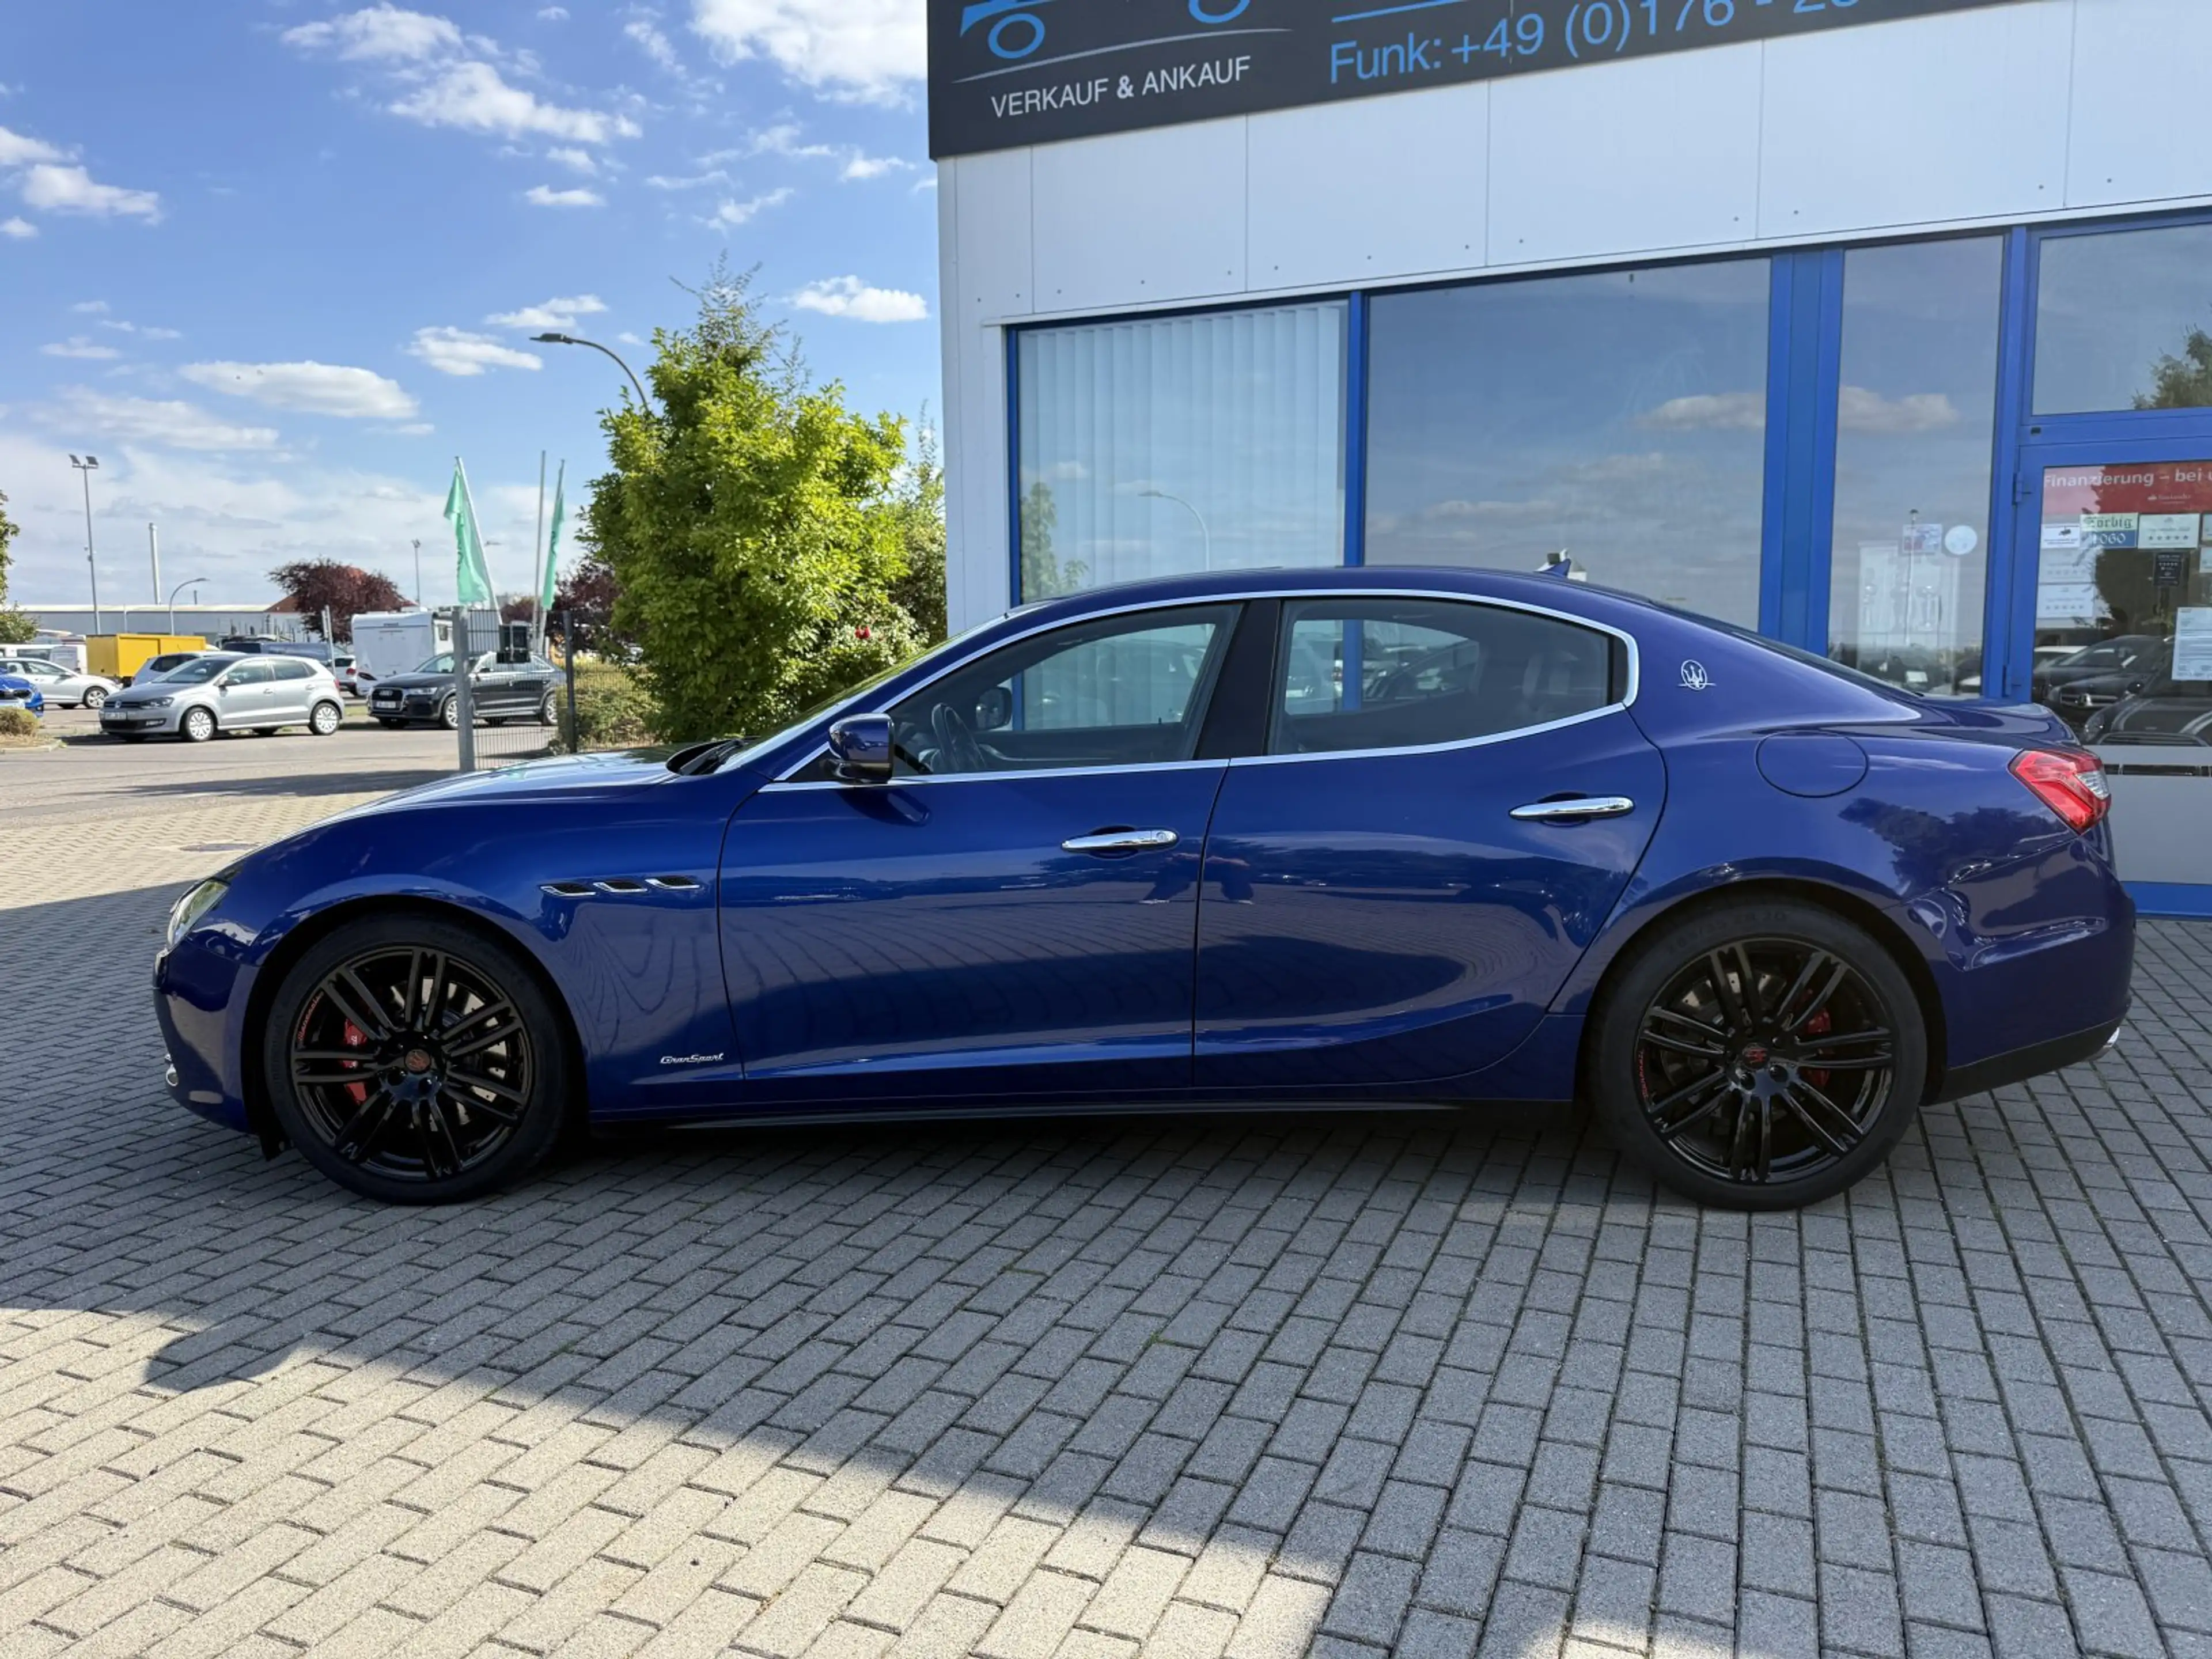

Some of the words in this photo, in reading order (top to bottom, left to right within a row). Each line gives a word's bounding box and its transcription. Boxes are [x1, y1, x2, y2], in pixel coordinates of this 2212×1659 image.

[991, 78, 1109, 118] VERKAUF
[1116, 74, 1135, 100] &
[1141, 55, 1251, 96] ANKAUF
[2044, 471, 2154, 488] Finanzierung
[2174, 467, 2202, 482] bei
[660, 1052, 724, 1065] GranSport
